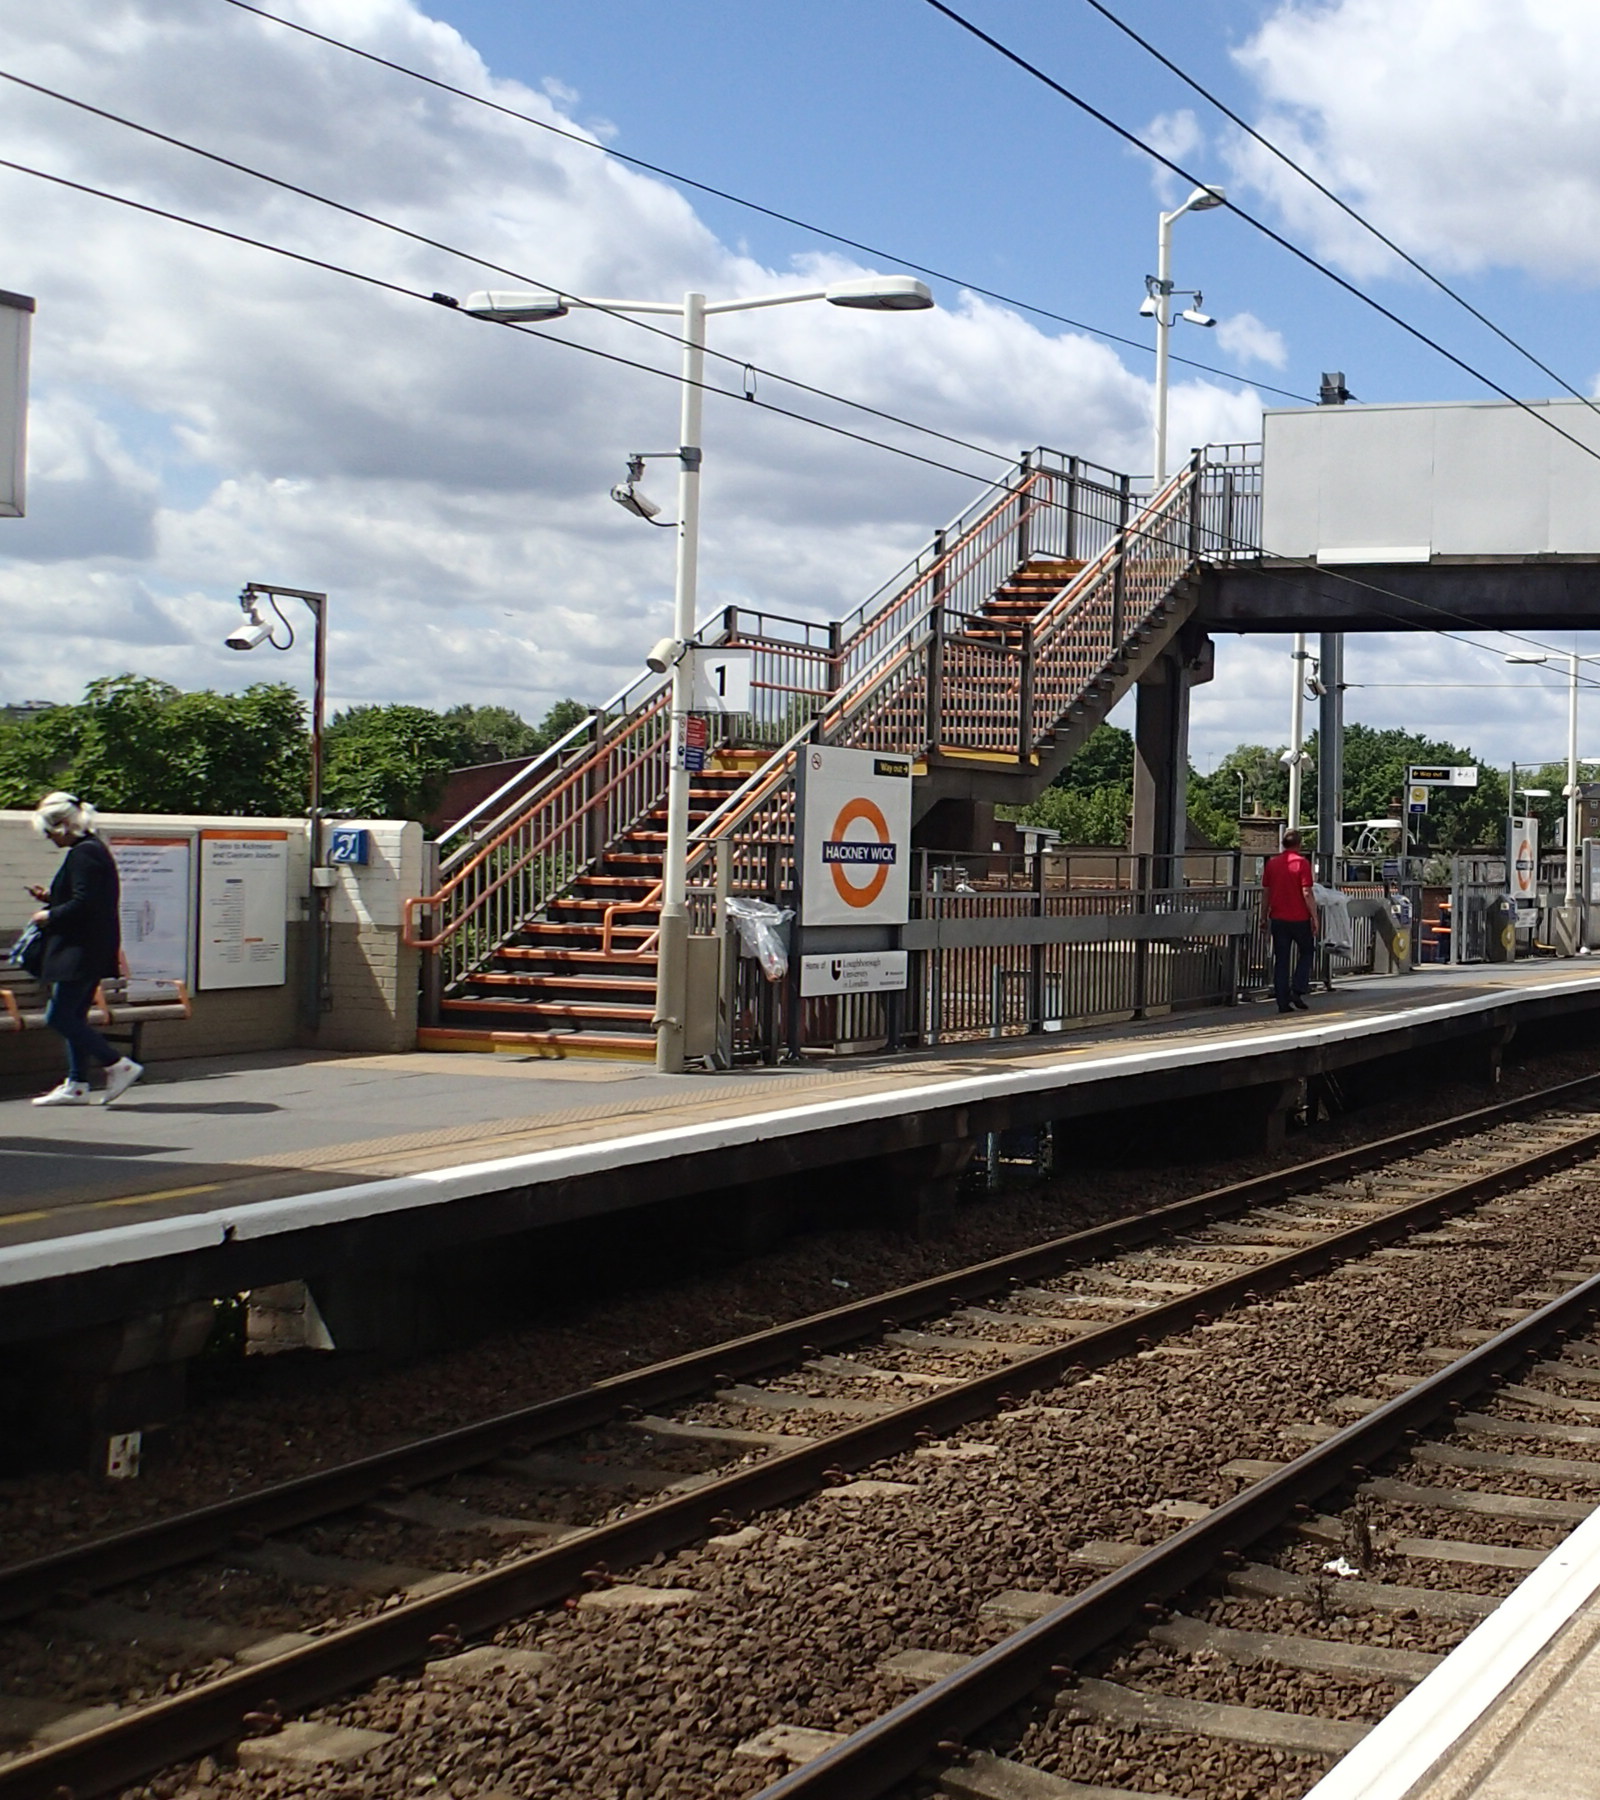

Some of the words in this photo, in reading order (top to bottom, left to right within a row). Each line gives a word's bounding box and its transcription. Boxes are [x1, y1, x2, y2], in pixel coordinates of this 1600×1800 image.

[715, 665, 726, 697] 1
[880, 762, 893, 774] Way
[893, 766, 904, 774] out
[1420, 770, 1432, 778] Way
[826, 846, 870, 860] HACKNEY
[870, 848, 894, 861] WICK
